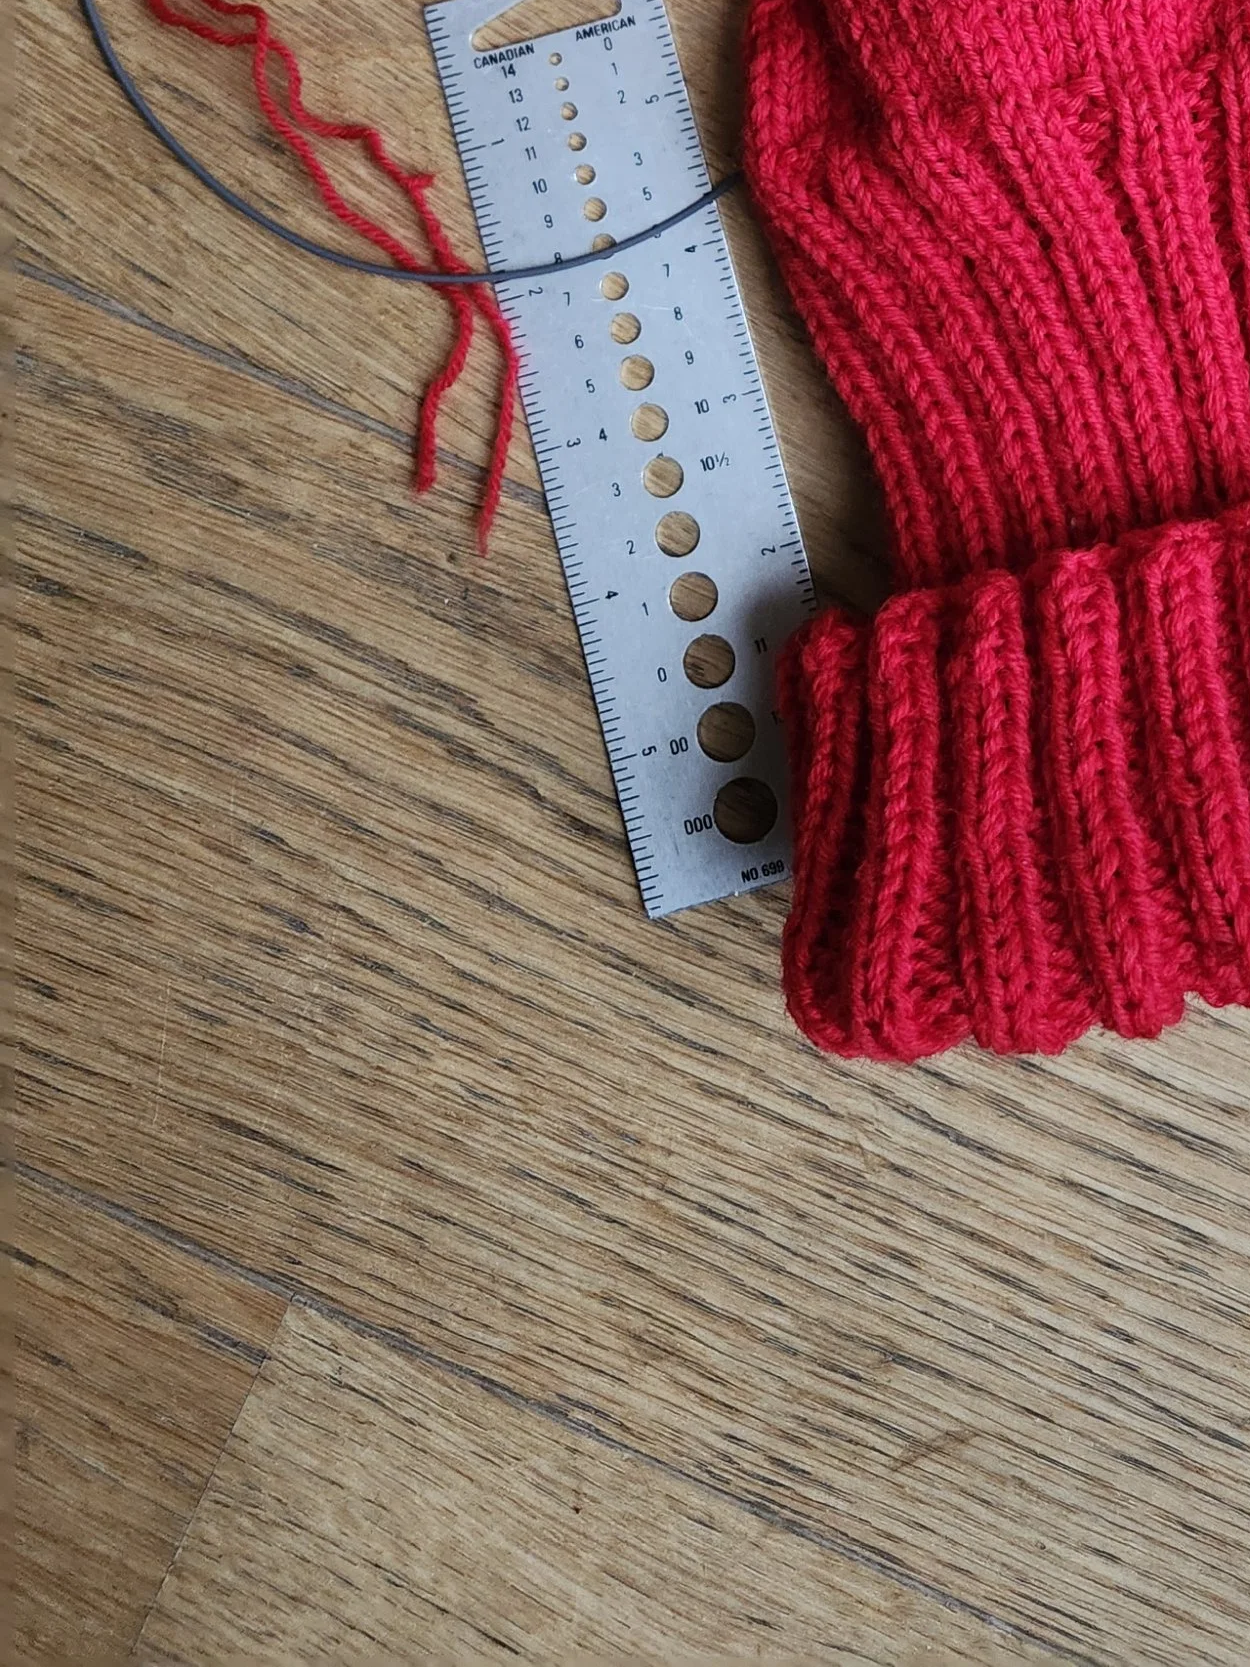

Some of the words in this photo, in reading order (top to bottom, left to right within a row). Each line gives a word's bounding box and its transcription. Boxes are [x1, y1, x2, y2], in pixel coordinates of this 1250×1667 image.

[575, 15, 637, 42] AMERICAN
[603, 36, 613, 51] 0
[473, 43, 535, 69] CANADIAN
[501, 63, 516, 79] 14
[611, 62, 619, 76] 1
[508, 88, 524, 104] 13
[617, 89, 626, 104] 2
[645, 94, 660, 105] 5
[516, 116, 531, 132] 12
[524, 146, 537, 161] 11
[633, 151, 643, 166] 3
[532, 178, 548, 195] 10
[642, 186, 652, 201] 5
[544, 214, 554, 228] 9
[662, 263, 670, 278] 7
[563, 291, 571, 306] 7
[673, 306, 683, 321] 8
[574, 334, 584, 349] 6
[684, 350, 695, 365] 9
[586, 378, 596, 393] 5
[694, 399, 710, 414] 10
[599, 428, 608, 442] 4
[611, 482, 621, 497] 3
[626, 540, 636, 555] 2
[642, 602, 649, 616] 1
[754, 637, 768, 654] 11
[657, 667, 667, 682] 0
[670, 737, 689, 755] 00
[684, 814, 712, 835] 000
